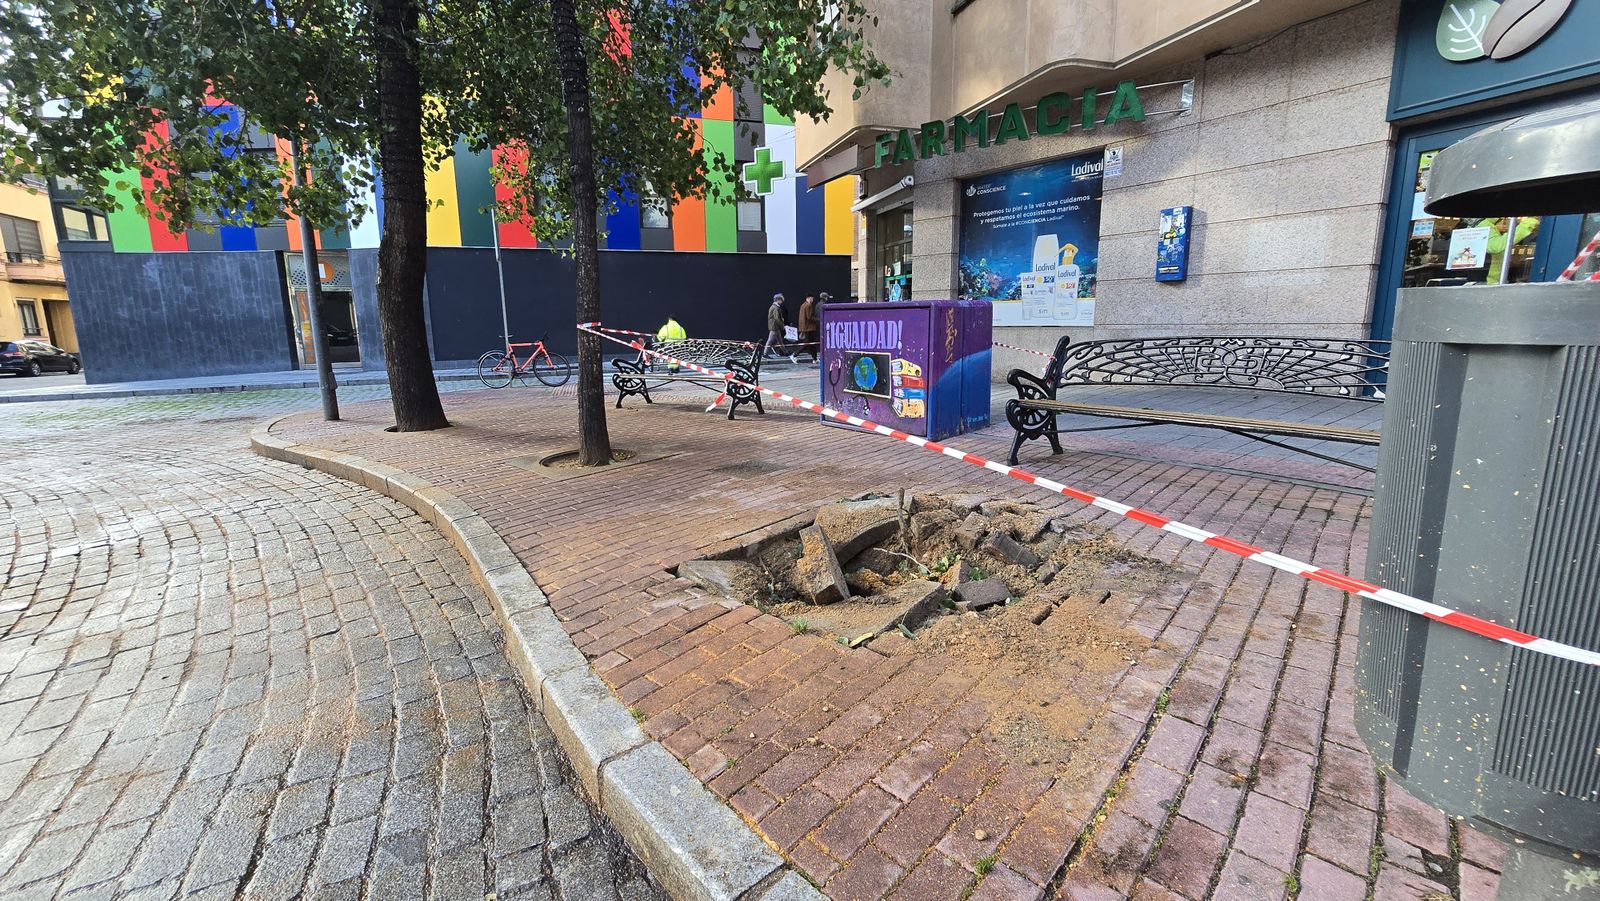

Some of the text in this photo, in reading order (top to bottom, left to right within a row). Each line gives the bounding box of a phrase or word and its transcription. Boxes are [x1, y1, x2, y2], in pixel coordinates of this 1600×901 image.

[874, 79, 1146, 169] FARMACIA
[1071, 158, 1104, 176] Ladival
[976, 184, 1007, 196] CONSCIENCE
[973, 208, 1004, 218] Protegemos
[1012, 204, 1023, 213] piel
[1046, 200, 1058, 208] que
[1060, 195, 1090, 205] cuidamos
[985, 214, 1016, 224] respetamos
[1023, 208, 1055, 218] ecosistema
[1057, 204, 1080, 213] marino.
[826, 319, 904, 350] ¡IGUALDAD!
